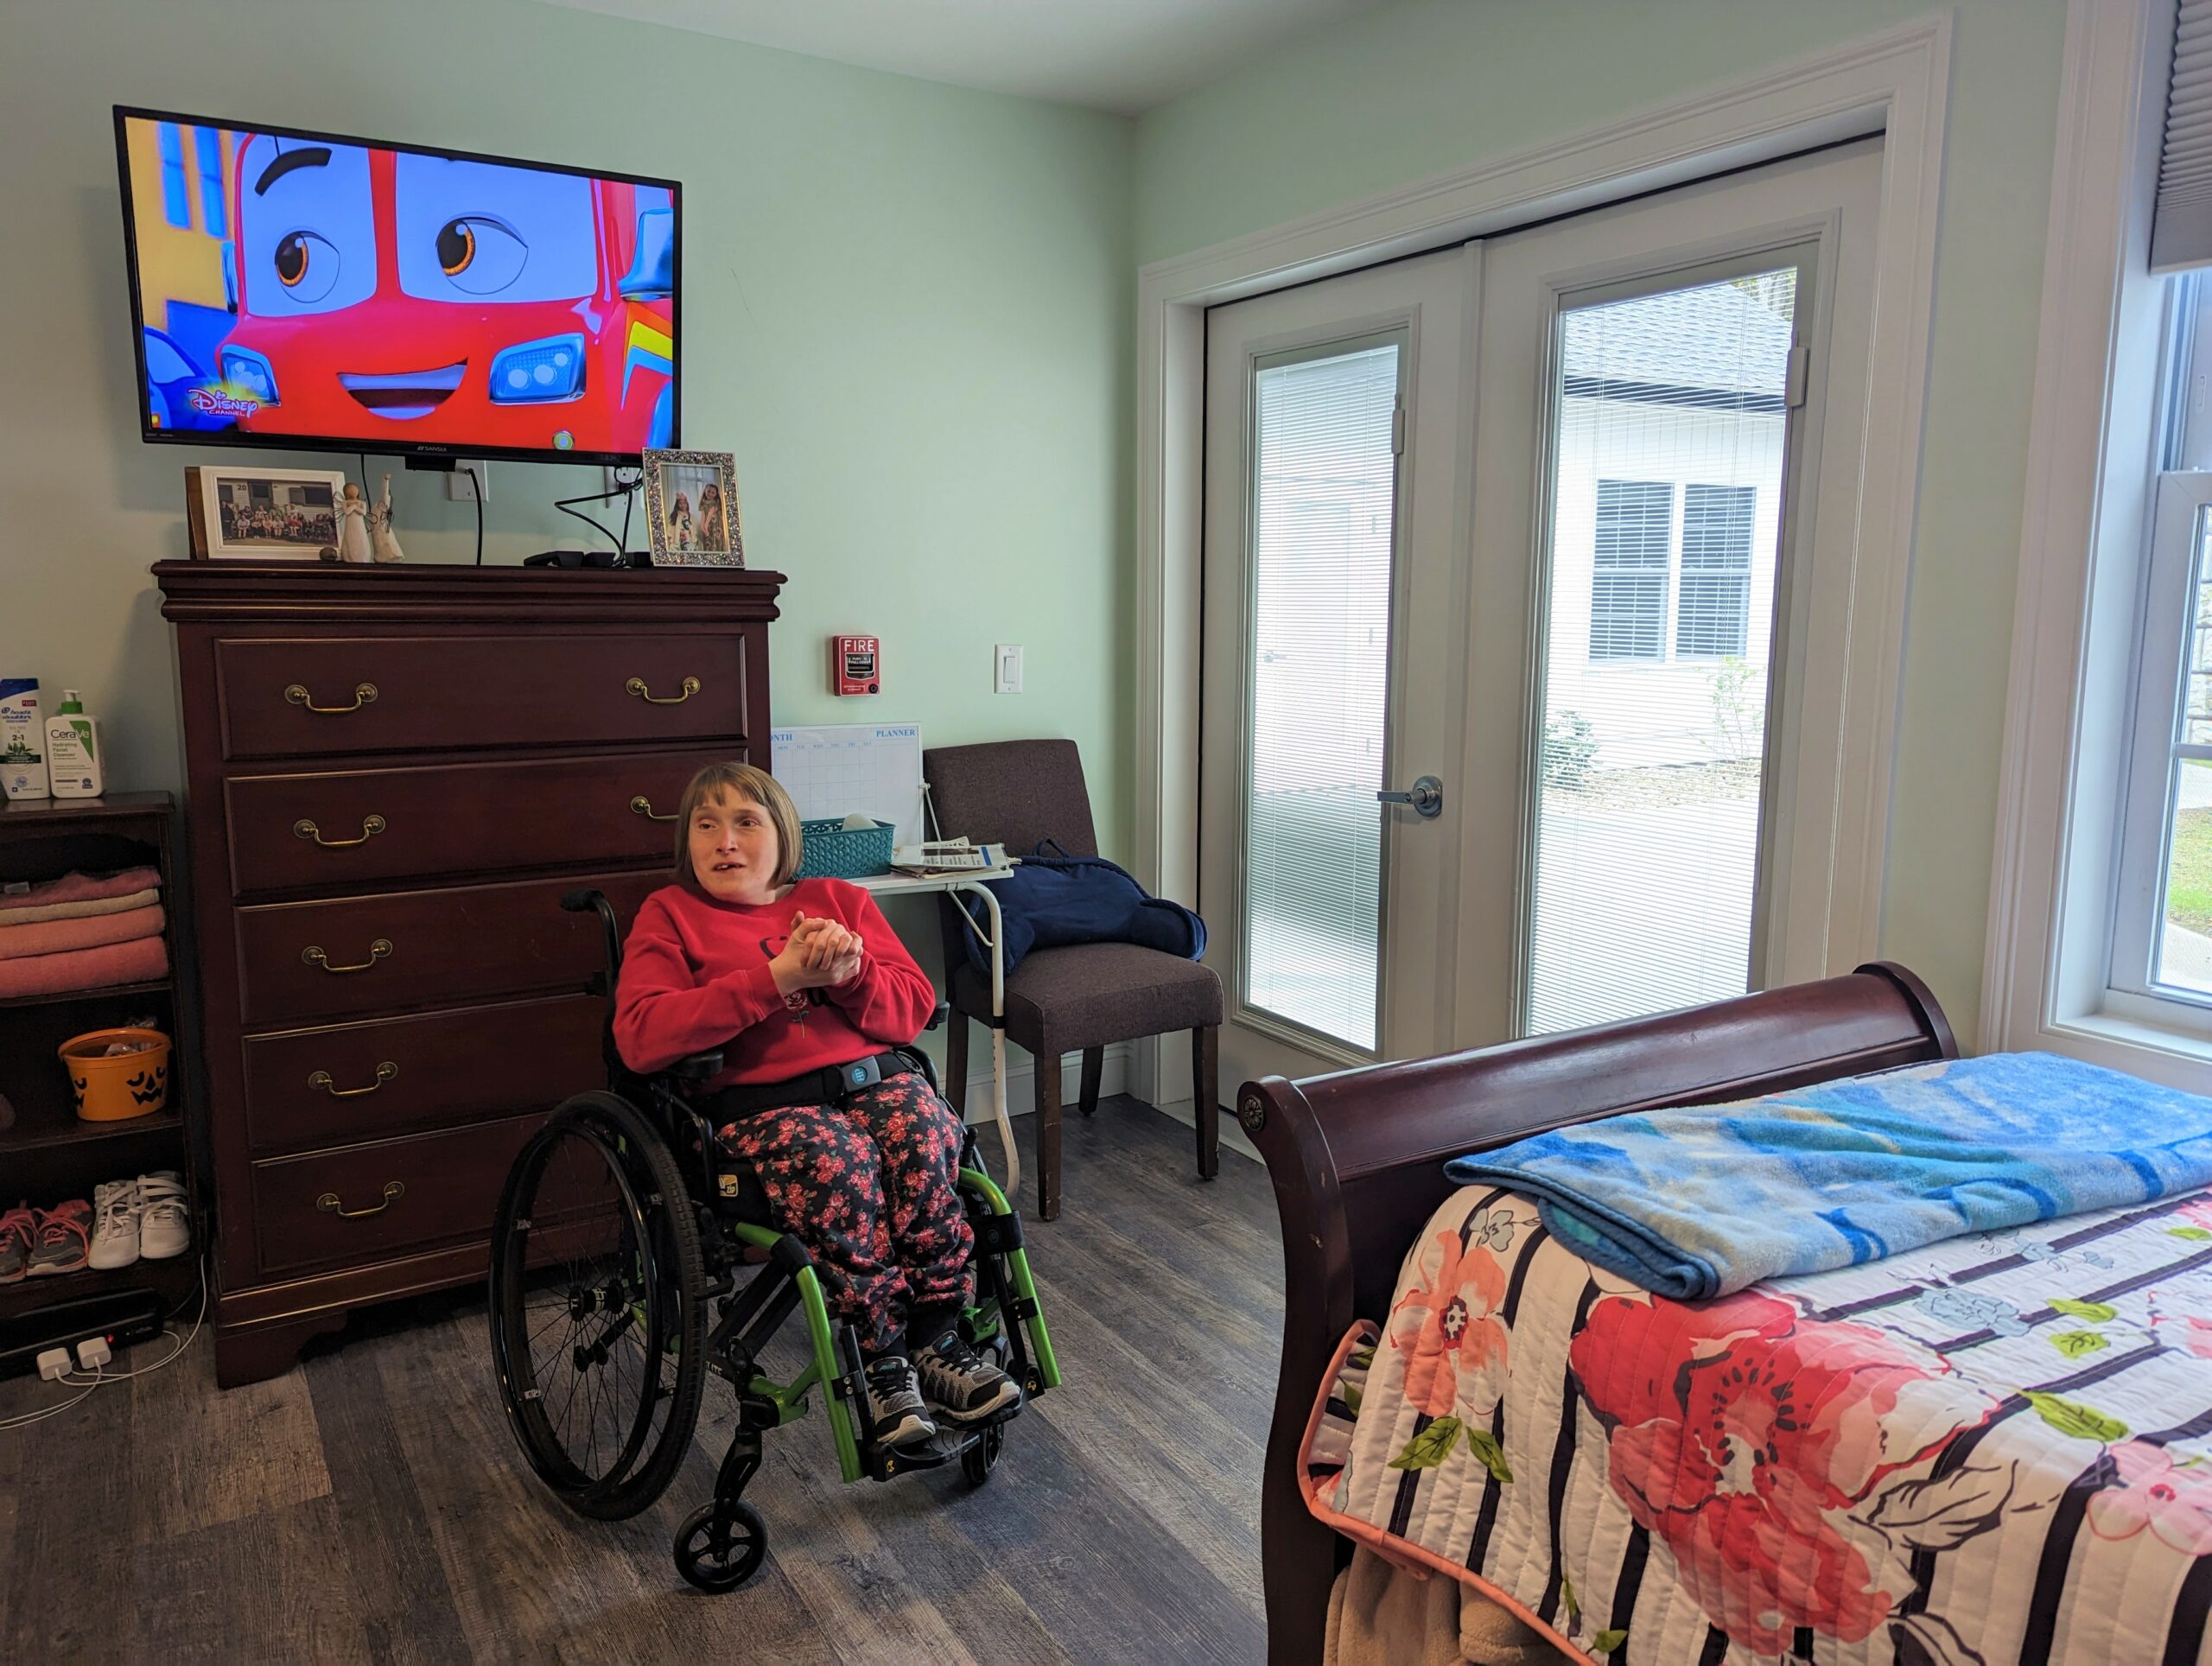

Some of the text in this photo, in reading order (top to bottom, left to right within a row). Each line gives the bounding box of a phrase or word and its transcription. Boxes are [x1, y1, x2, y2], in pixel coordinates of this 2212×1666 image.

[843, 639, 875, 652] FIRE
[50, 729, 90, 739] CeraVe
[876, 728, 916, 738] PLANNER
